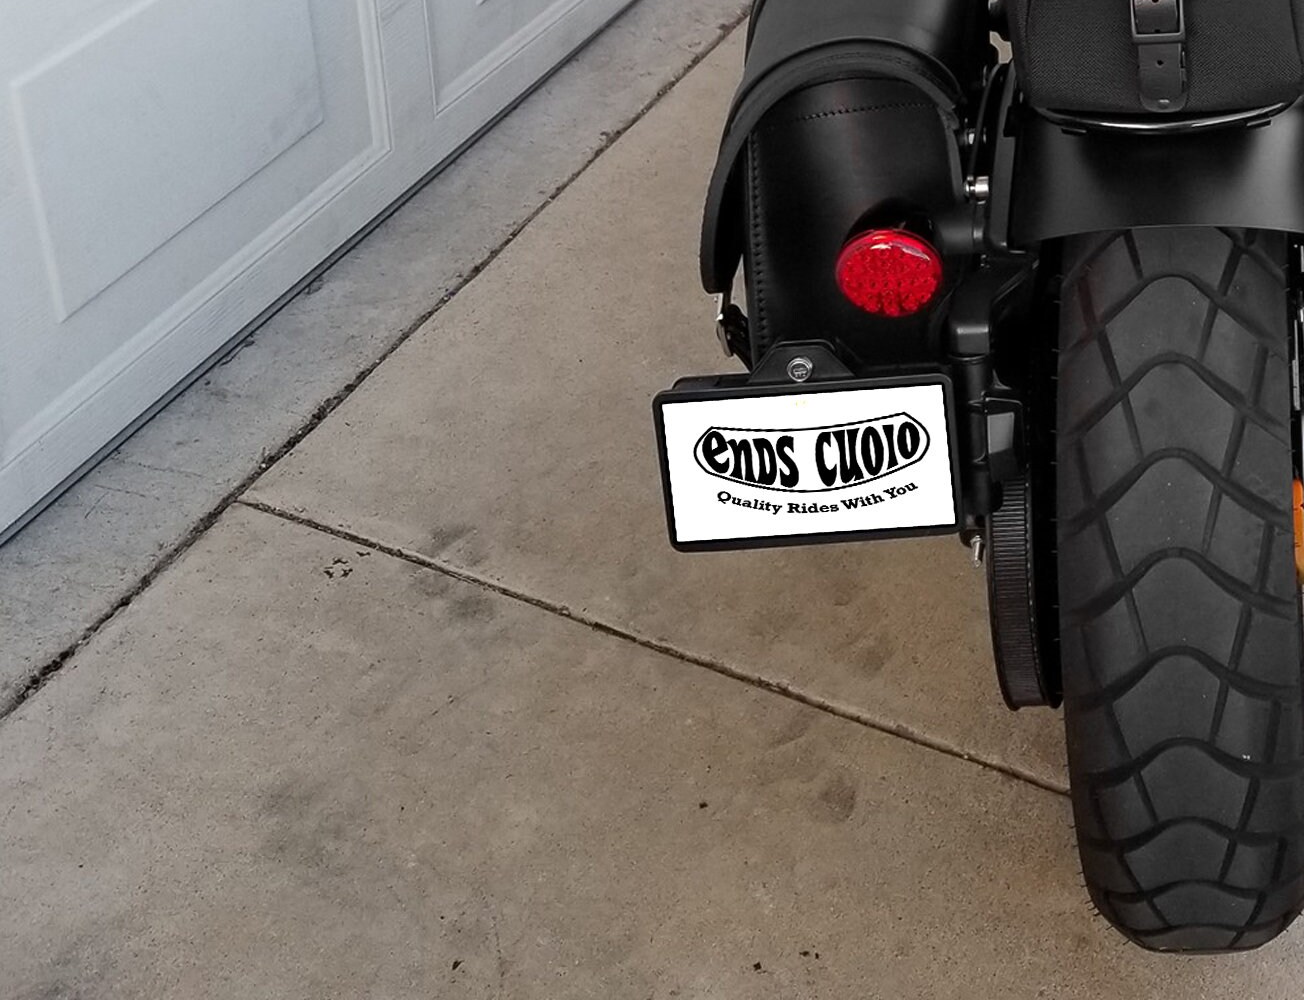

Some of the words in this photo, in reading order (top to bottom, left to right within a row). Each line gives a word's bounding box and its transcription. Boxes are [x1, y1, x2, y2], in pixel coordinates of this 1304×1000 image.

[717, 490, 783, 516] Quality
[787, 502, 840, 514] Rides
[840, 493, 886, 510] With
[882, 482, 919, 500] You
